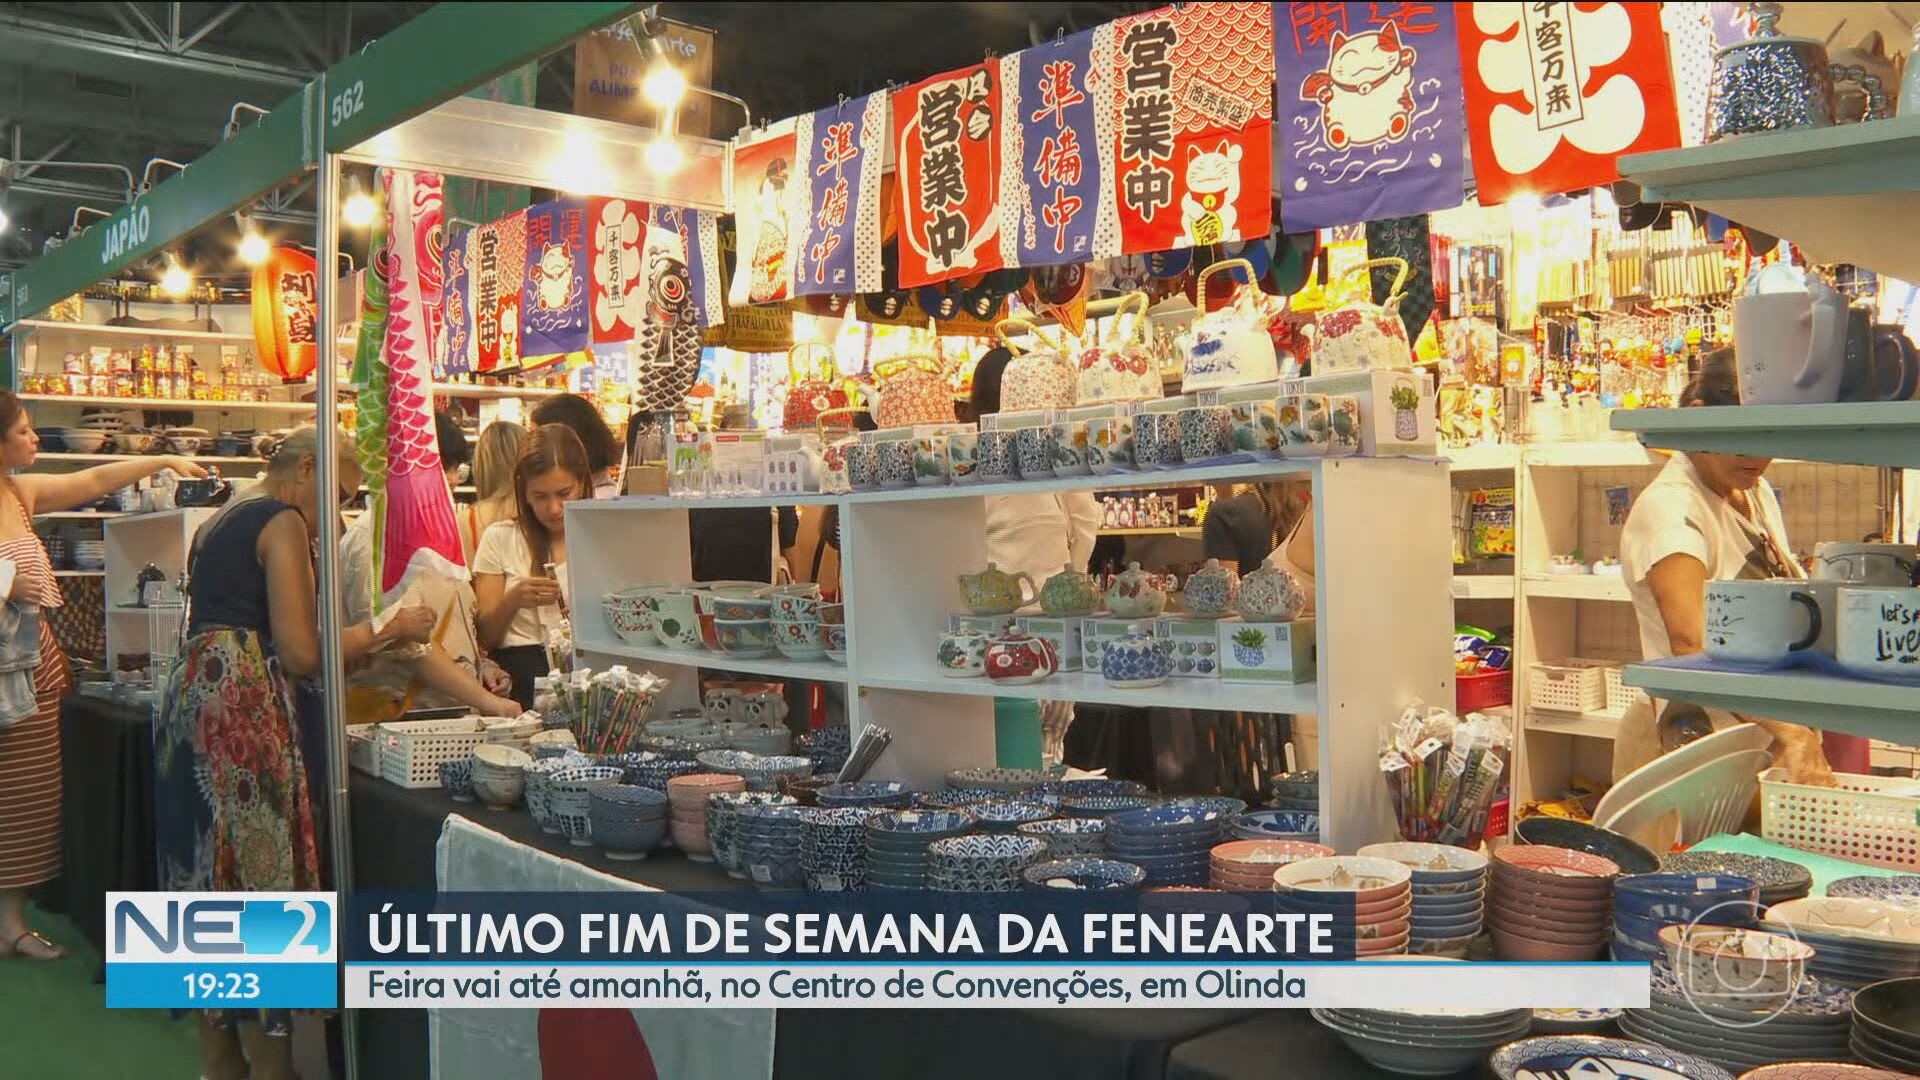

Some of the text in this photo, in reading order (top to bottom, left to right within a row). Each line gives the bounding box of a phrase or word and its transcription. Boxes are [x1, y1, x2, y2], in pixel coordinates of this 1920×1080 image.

[332, 79, 364, 127] 562
[921, 83, 967, 268] 営業中
[1032, 62, 1083, 252] 準備中
[1122, 20, 1177, 222] 営業中
[102, 205, 149, 264] JAPÃO
[812, 122, 857, 284] 準備中
[480, 229, 498, 351] 営業中
